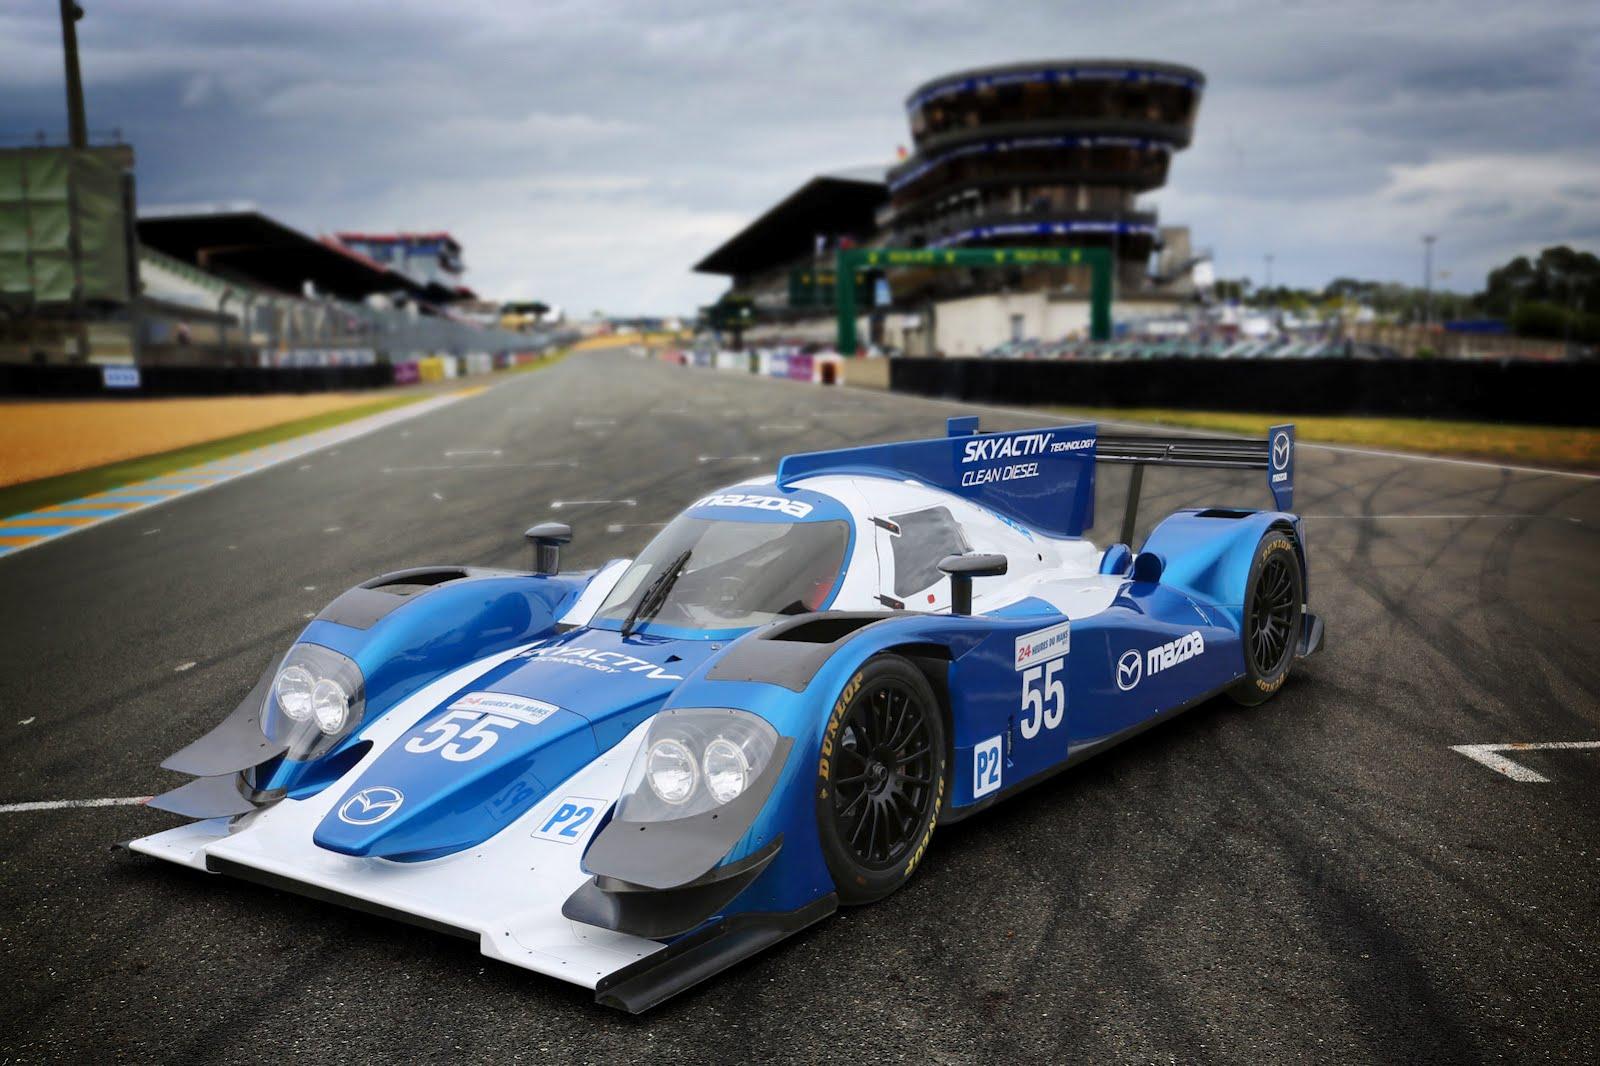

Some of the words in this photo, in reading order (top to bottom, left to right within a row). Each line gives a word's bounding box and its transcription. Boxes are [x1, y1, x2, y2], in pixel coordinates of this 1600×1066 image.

[962, 433, 1051, 463] SKYACTIV
[1050, 438, 1096, 453] TECHNOLOGY
[962, 467, 1002, 487] CLEAN
[1002, 462, 1039, 481] DIESEL
[1262, 540, 1291, 562] DUNLOP
[1018, 644, 1031, 662] 24
[1147, 630, 1204, 676] mazda
[1021, 657, 1065, 740] 55
[405, 710, 520, 762] 55
[819, 671, 863, 781] DUNLOP
[977, 746, 999, 790] P2
[541, 803, 595, 837] P2
